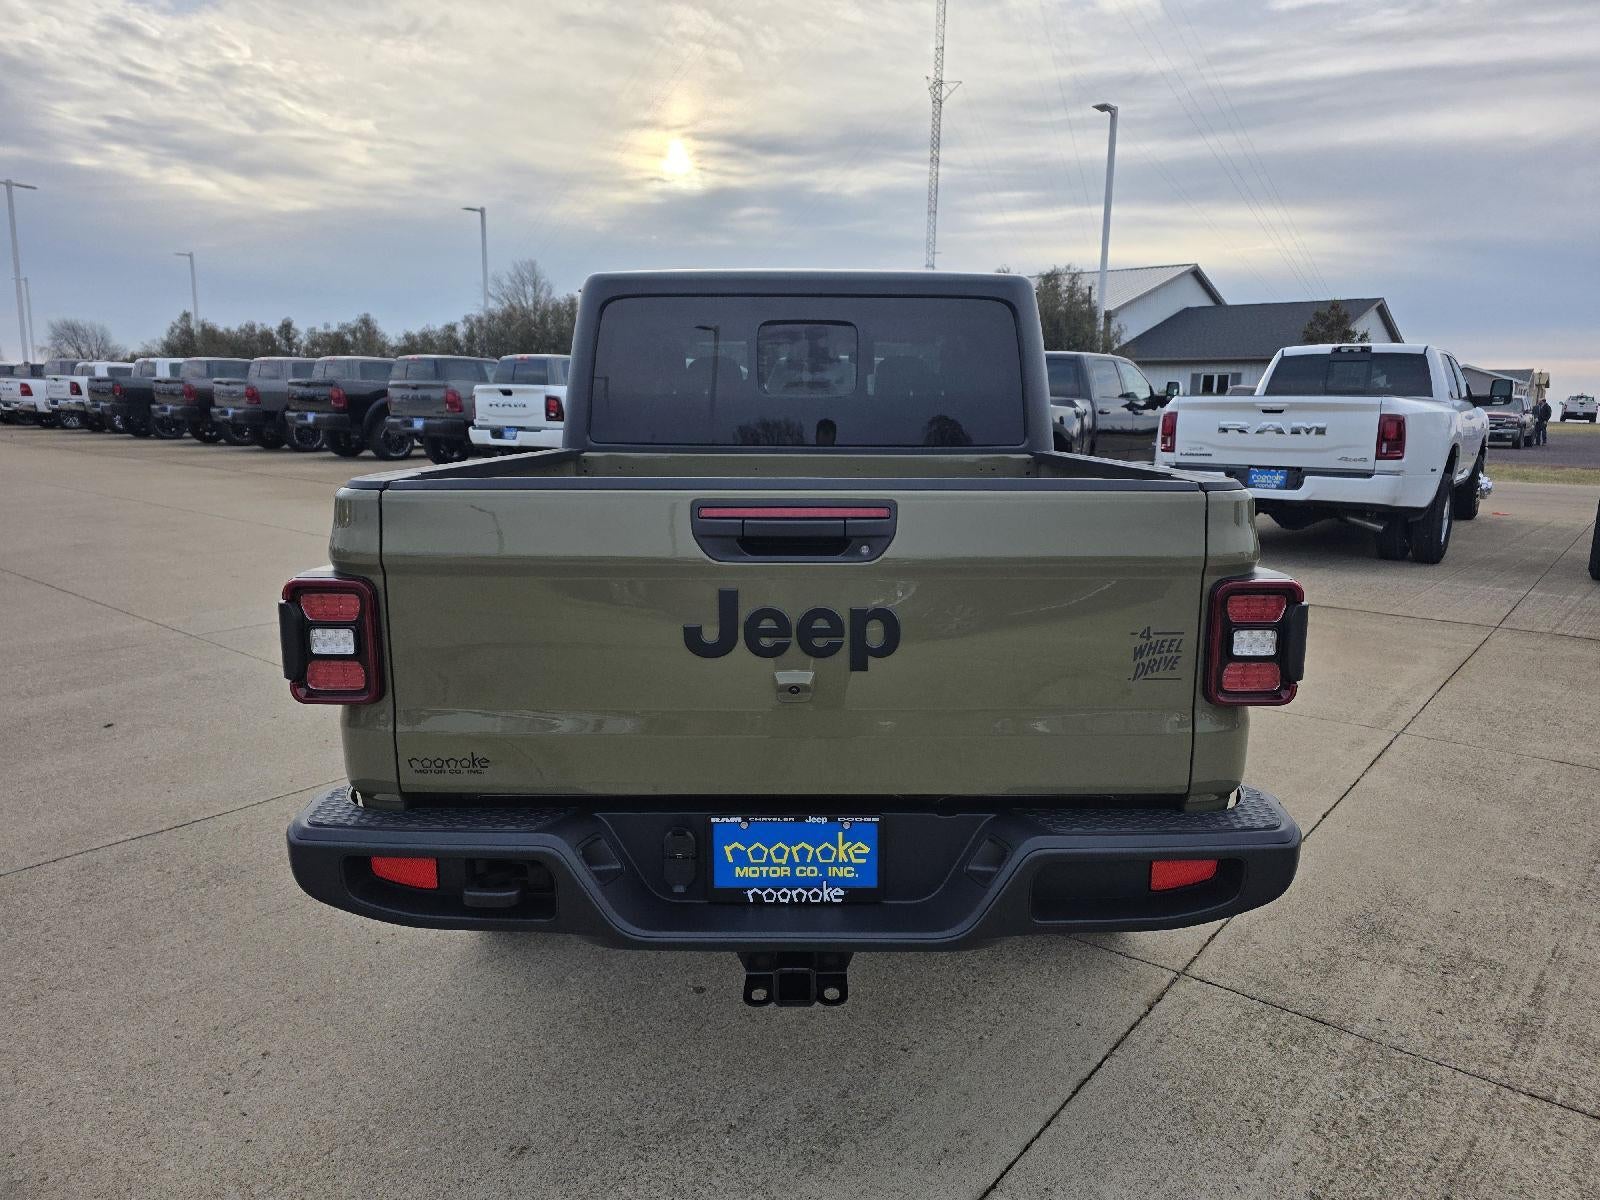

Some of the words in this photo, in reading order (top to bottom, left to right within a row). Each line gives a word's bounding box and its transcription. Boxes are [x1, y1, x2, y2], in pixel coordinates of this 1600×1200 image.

[1217, 421, 1328, 435] RAM
[683, 587, 900, 672] Jeep
[1139, 626, 1153, 641] 4
[1133, 638, 1183, 661] WHEEL
[1132, 656, 1182, 681] DRIVE
[805, 815, 828, 824] Jeep
[735, 867, 791, 877] MOTOR
[796, 867, 823, 877] CO.
[828, 867, 859, 877] INC.
